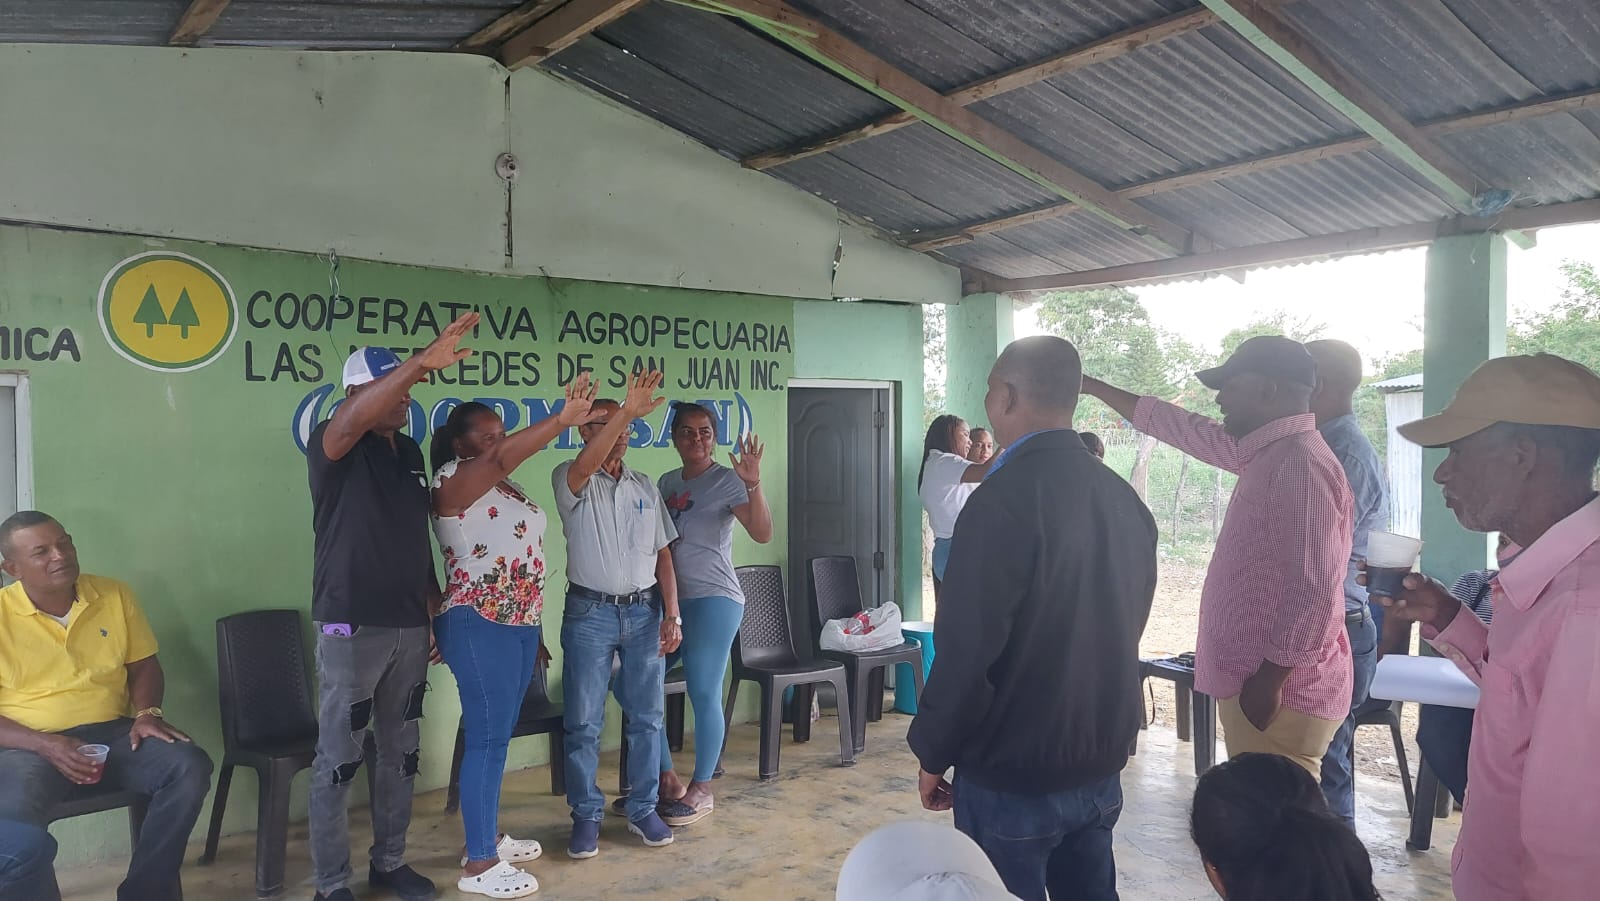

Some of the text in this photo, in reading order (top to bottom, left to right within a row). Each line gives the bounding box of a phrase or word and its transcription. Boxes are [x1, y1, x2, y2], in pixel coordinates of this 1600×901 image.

[245, 290, 792, 353] COOPERATIVA AGROPECUARIA
[245, 340, 324, 382] LAS
[557, 353, 594, 387] DE
[607, 355, 665, 388] SAN
[677, 357, 740, 390] JUAN
[750, 359, 784, 391] INC.
